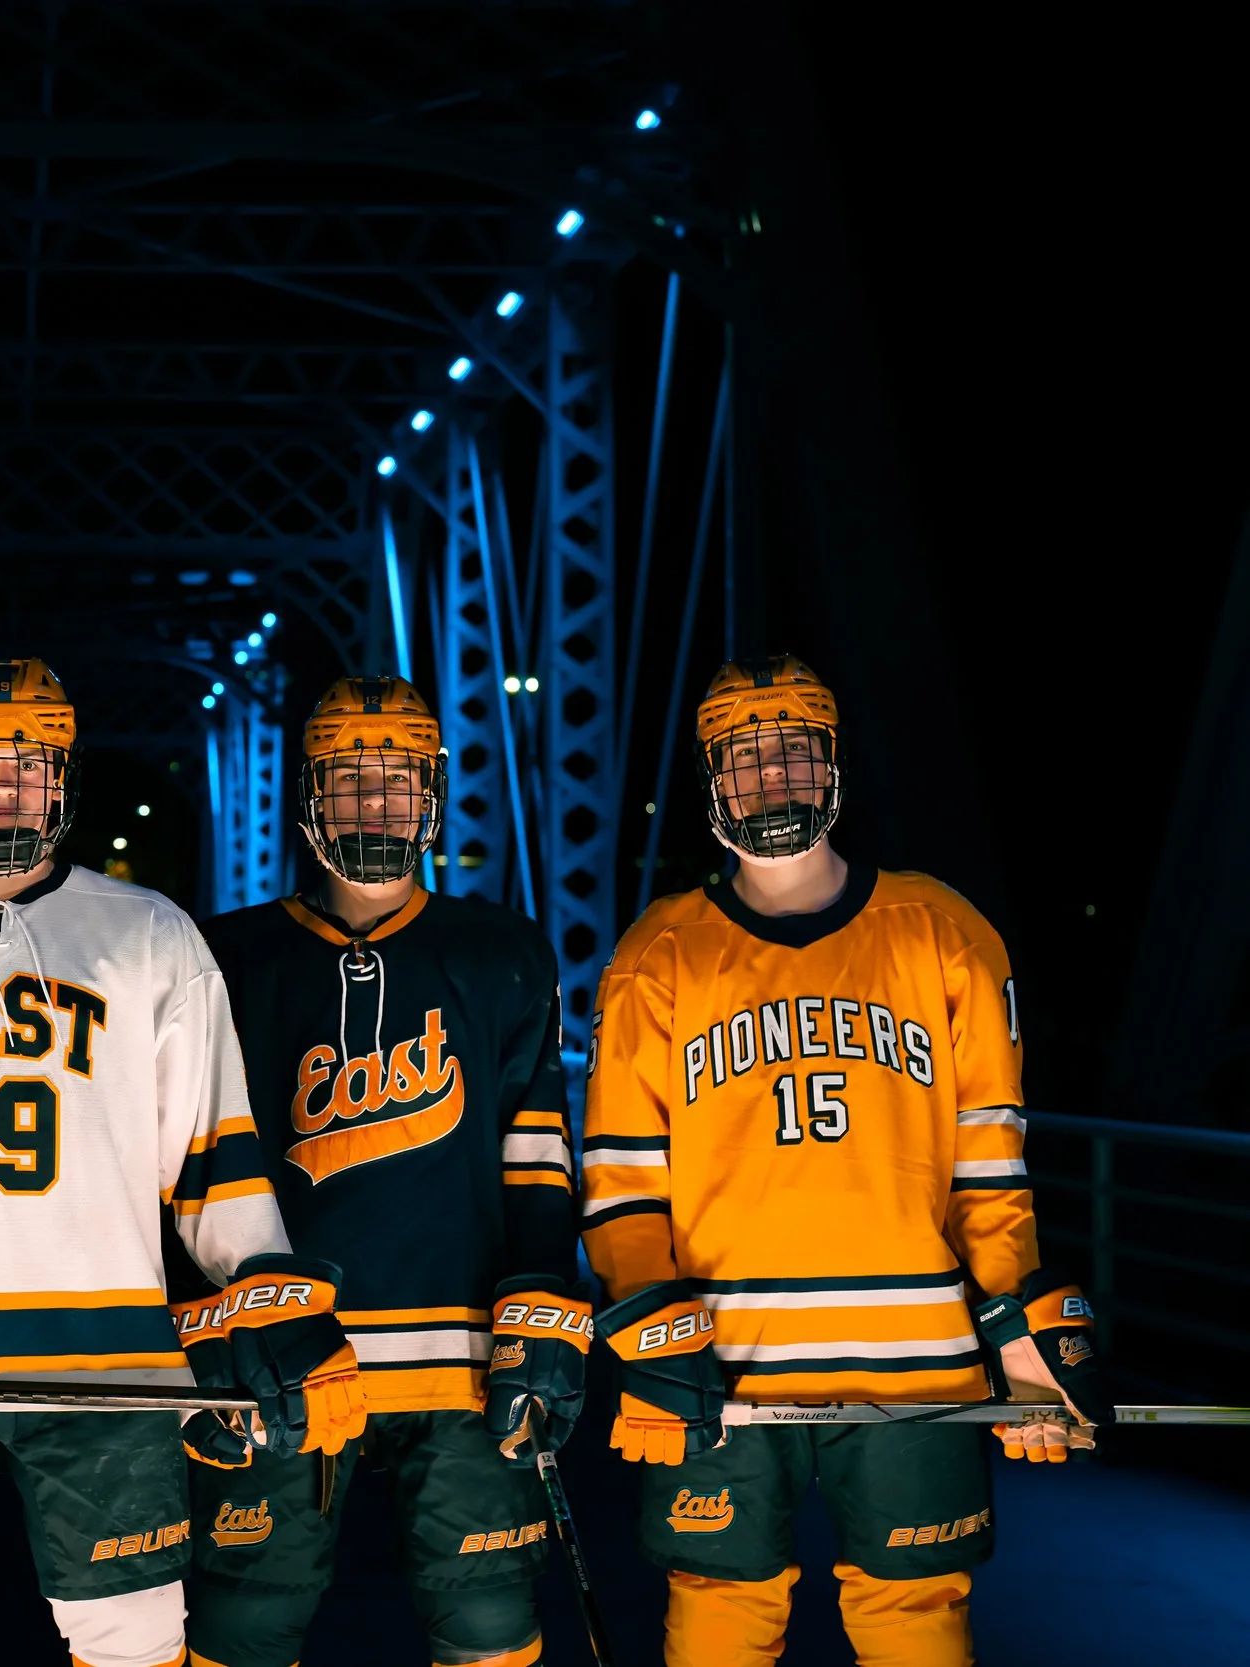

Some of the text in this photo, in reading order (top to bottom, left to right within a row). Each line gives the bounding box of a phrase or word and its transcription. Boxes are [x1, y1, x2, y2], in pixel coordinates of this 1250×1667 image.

[365, 695, 380, 705] 12
[684, 997, 934, 1107] PIONEERS
[290, 1008, 456, 1136] East
[772, 1072, 849, 1146] 15
[979, 1304, 1006, 1323] BAUER
[782, 1411, 838, 1421] BAUER
[214, 1500, 269, 1531] East
[670, 1488, 731, 1517] East
[90, 1519, 190, 1562] BAUER
[458, 1520, 547, 1554] BAUER
[886, 1508, 990, 1547] BAUER
